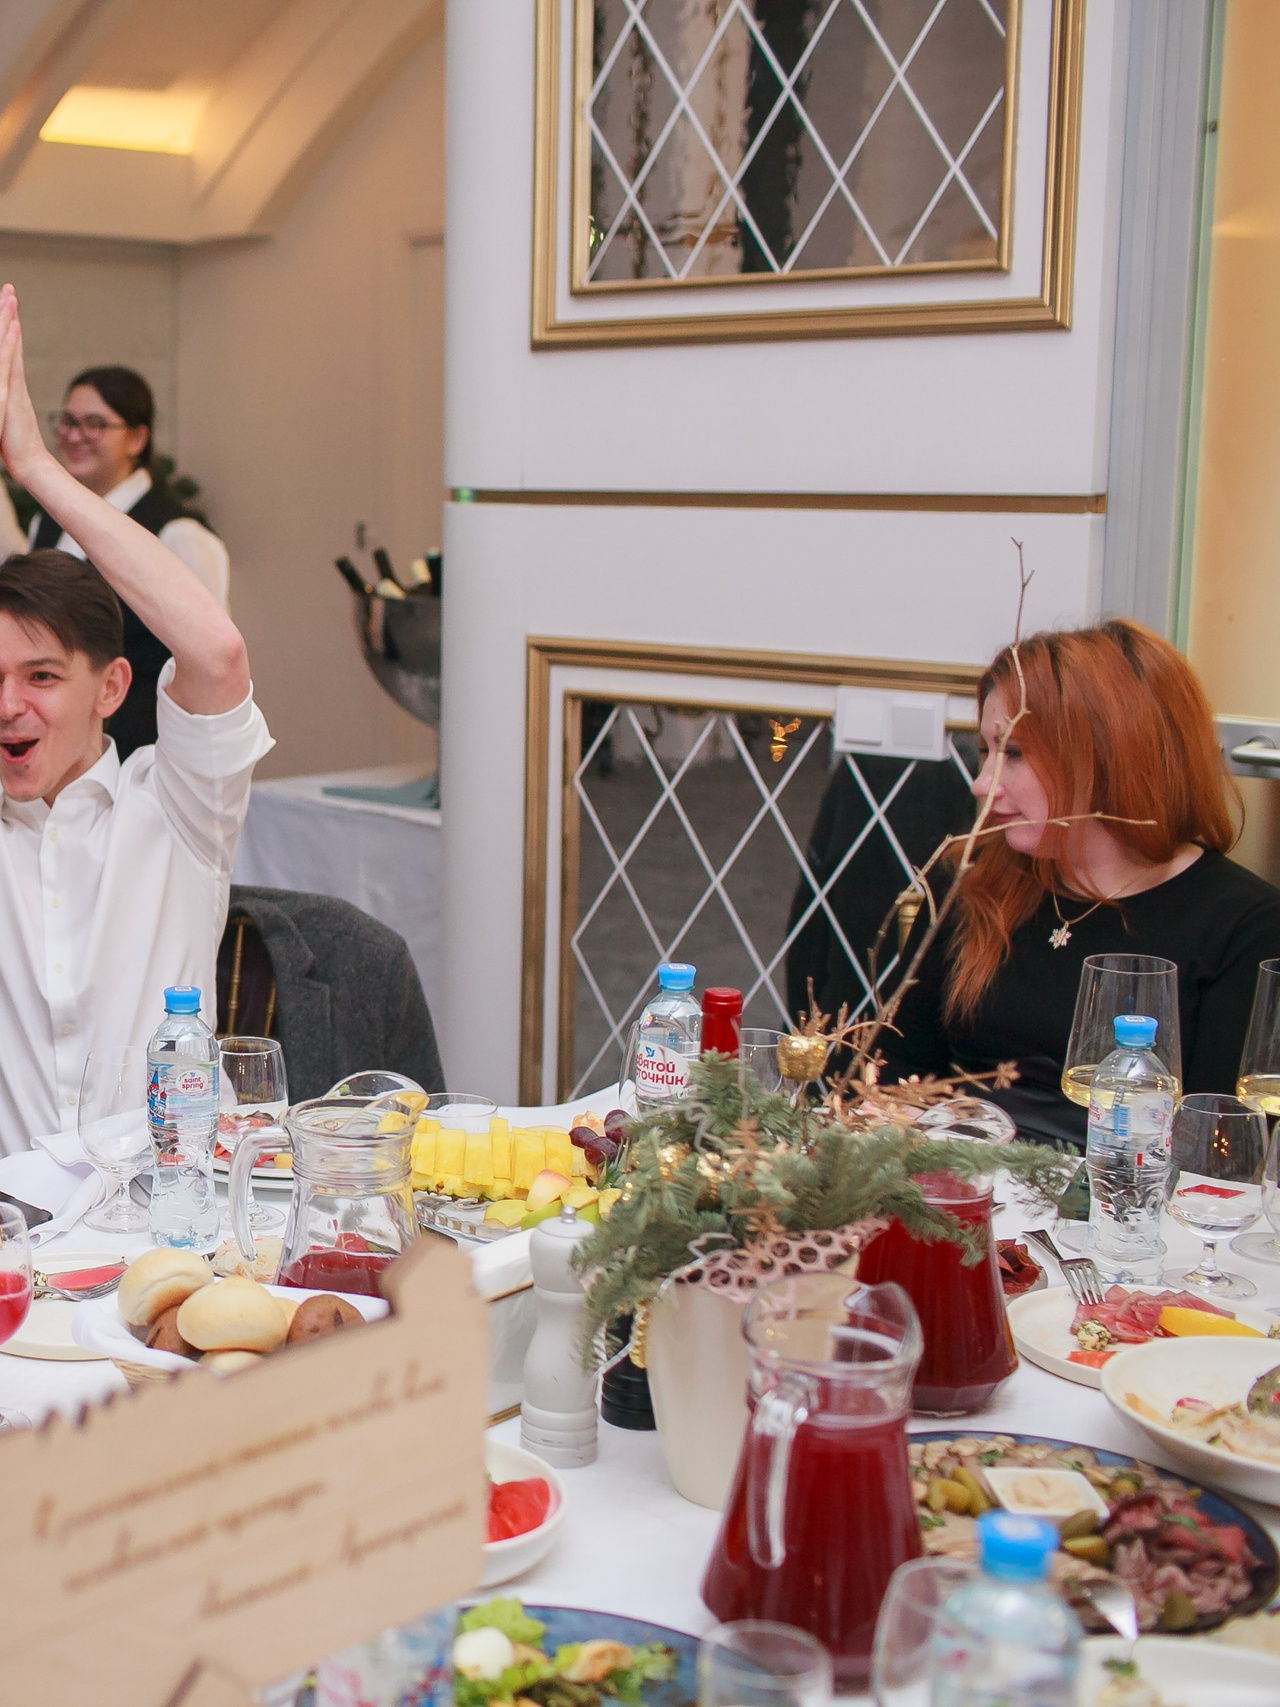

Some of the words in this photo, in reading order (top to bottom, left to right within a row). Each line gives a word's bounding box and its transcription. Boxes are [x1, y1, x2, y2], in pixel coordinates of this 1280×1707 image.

[637, 1053, 675, 1073] ВЯТОЙ
[636, 1066, 684, 1086] ТОЧНИК
[181, 1082, 204, 1091] spring
